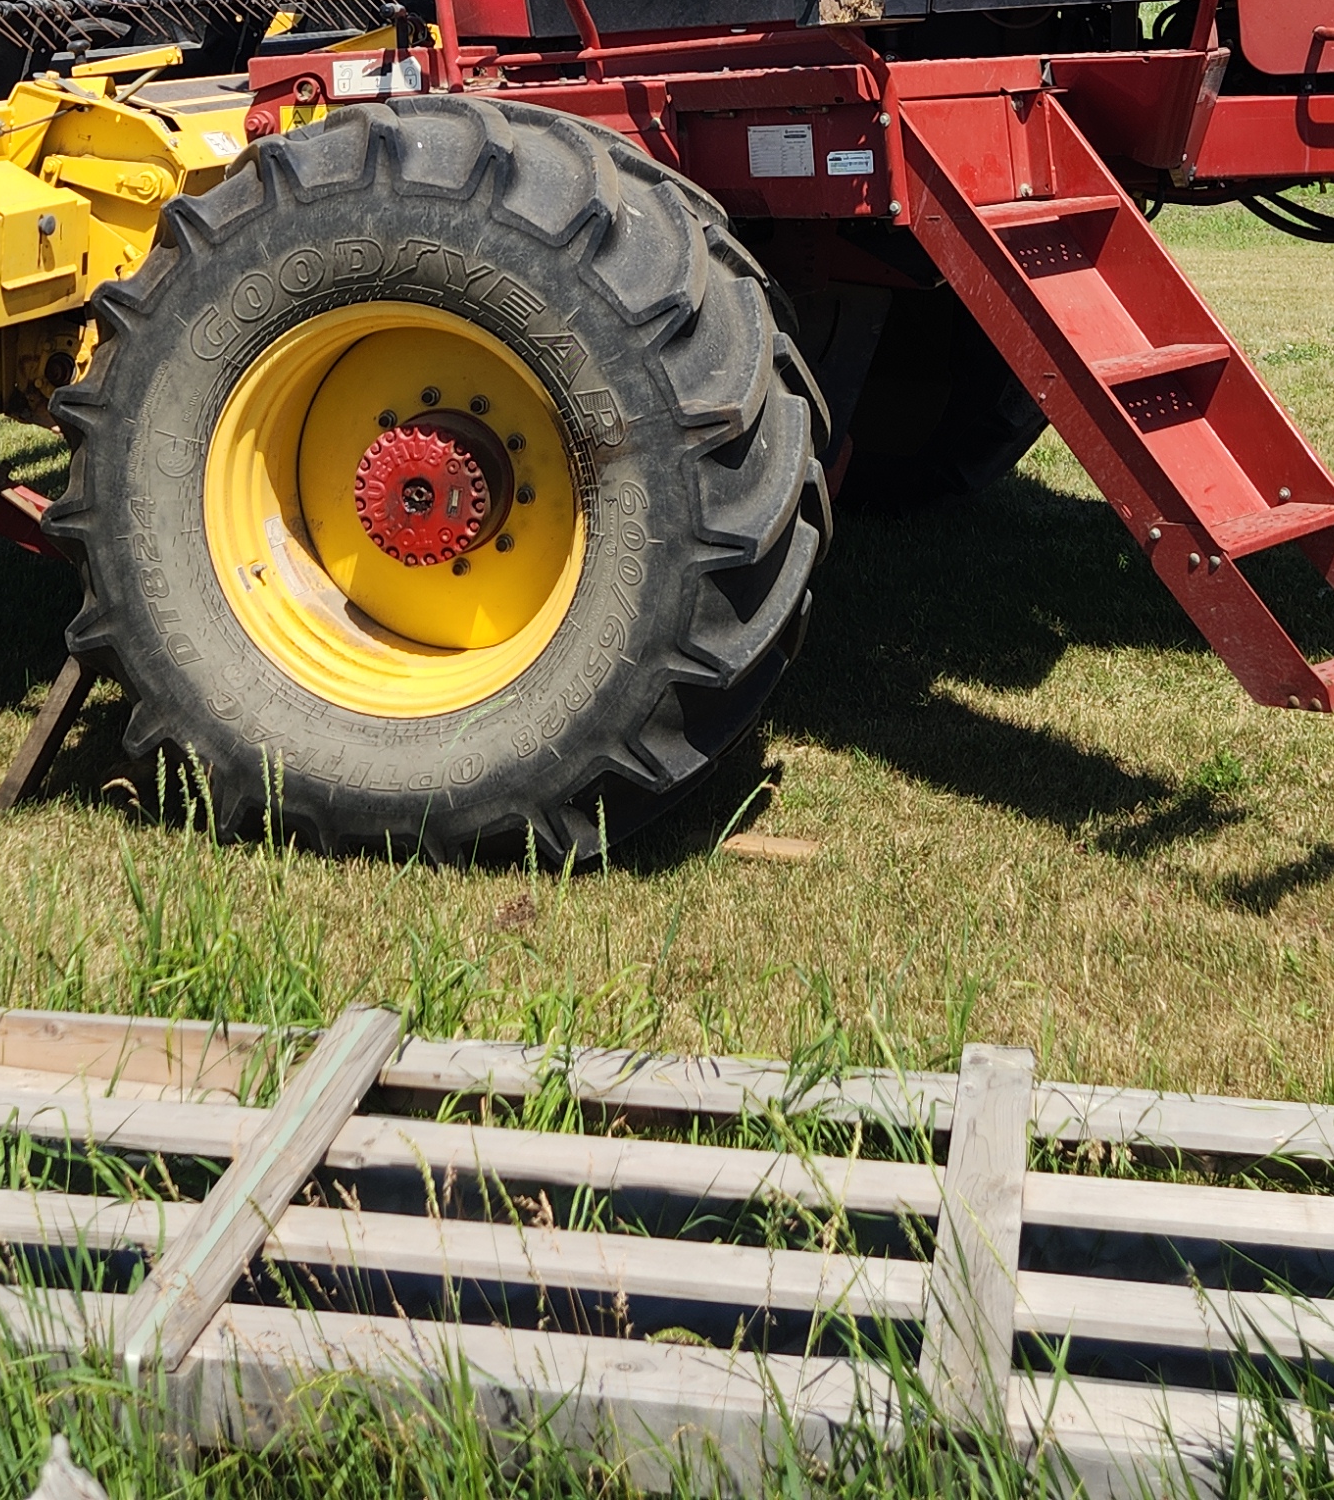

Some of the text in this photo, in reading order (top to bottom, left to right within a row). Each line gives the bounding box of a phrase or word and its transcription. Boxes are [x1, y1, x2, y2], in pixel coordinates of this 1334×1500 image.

[189, 237, 630, 449] GOODYEAR
[130, 496, 485, 792] OPTITRAC DT824
[511, 480, 649, 758] 600/65R28
